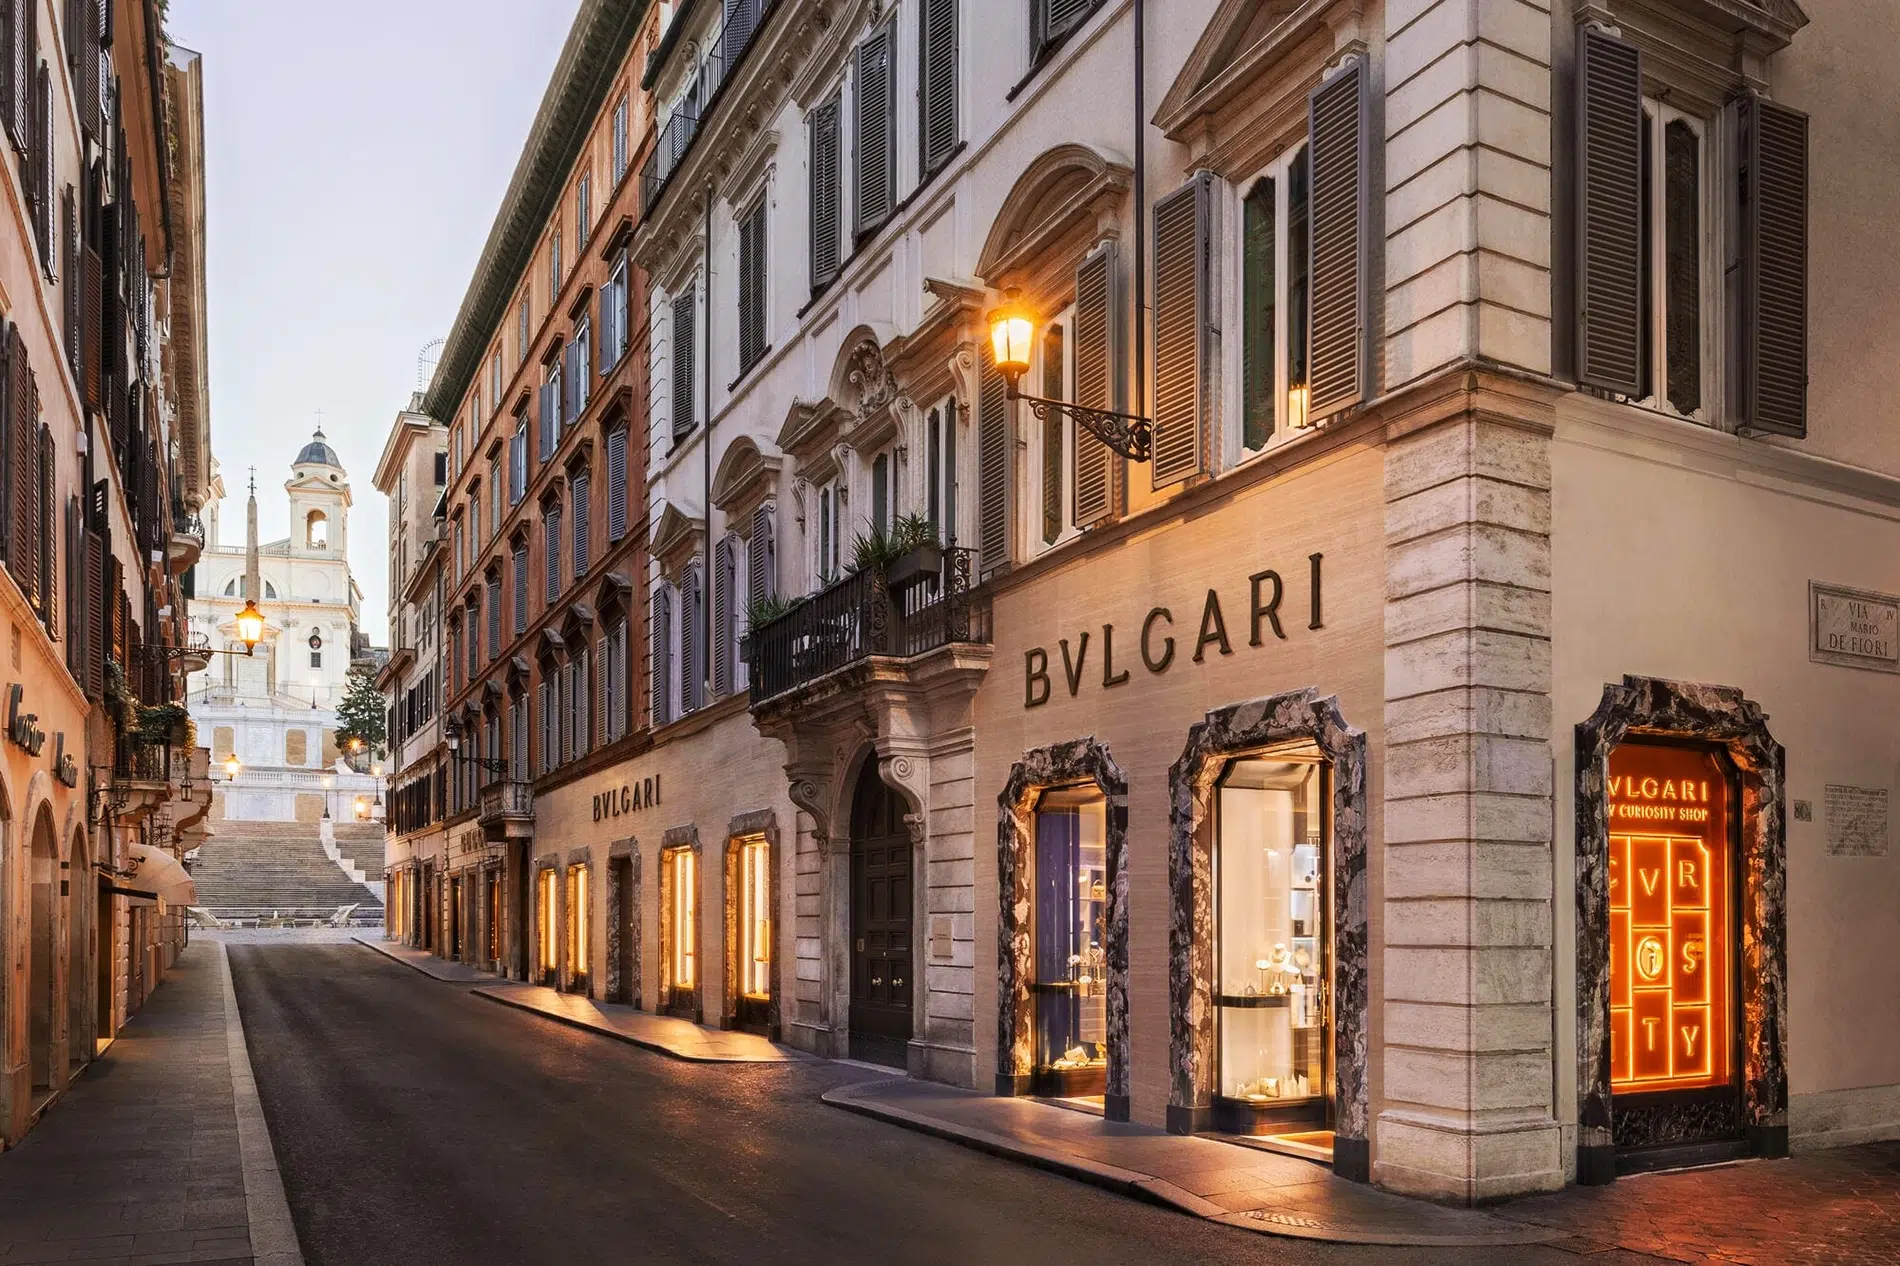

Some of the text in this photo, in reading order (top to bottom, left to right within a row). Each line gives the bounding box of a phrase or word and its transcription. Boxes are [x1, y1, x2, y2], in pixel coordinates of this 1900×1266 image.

[1848, 601, 1869, 620] VIA
[1024, 552, 1323, 709] BVLGARI
[1850, 621, 1879, 636] MARIO
[1852, 636, 1888, 657] FIORI
[593, 773, 660, 822] BVLGARI
[1620, 804, 1675, 820] CURIOSITY
[1680, 807, 1708, 821] SHOP
